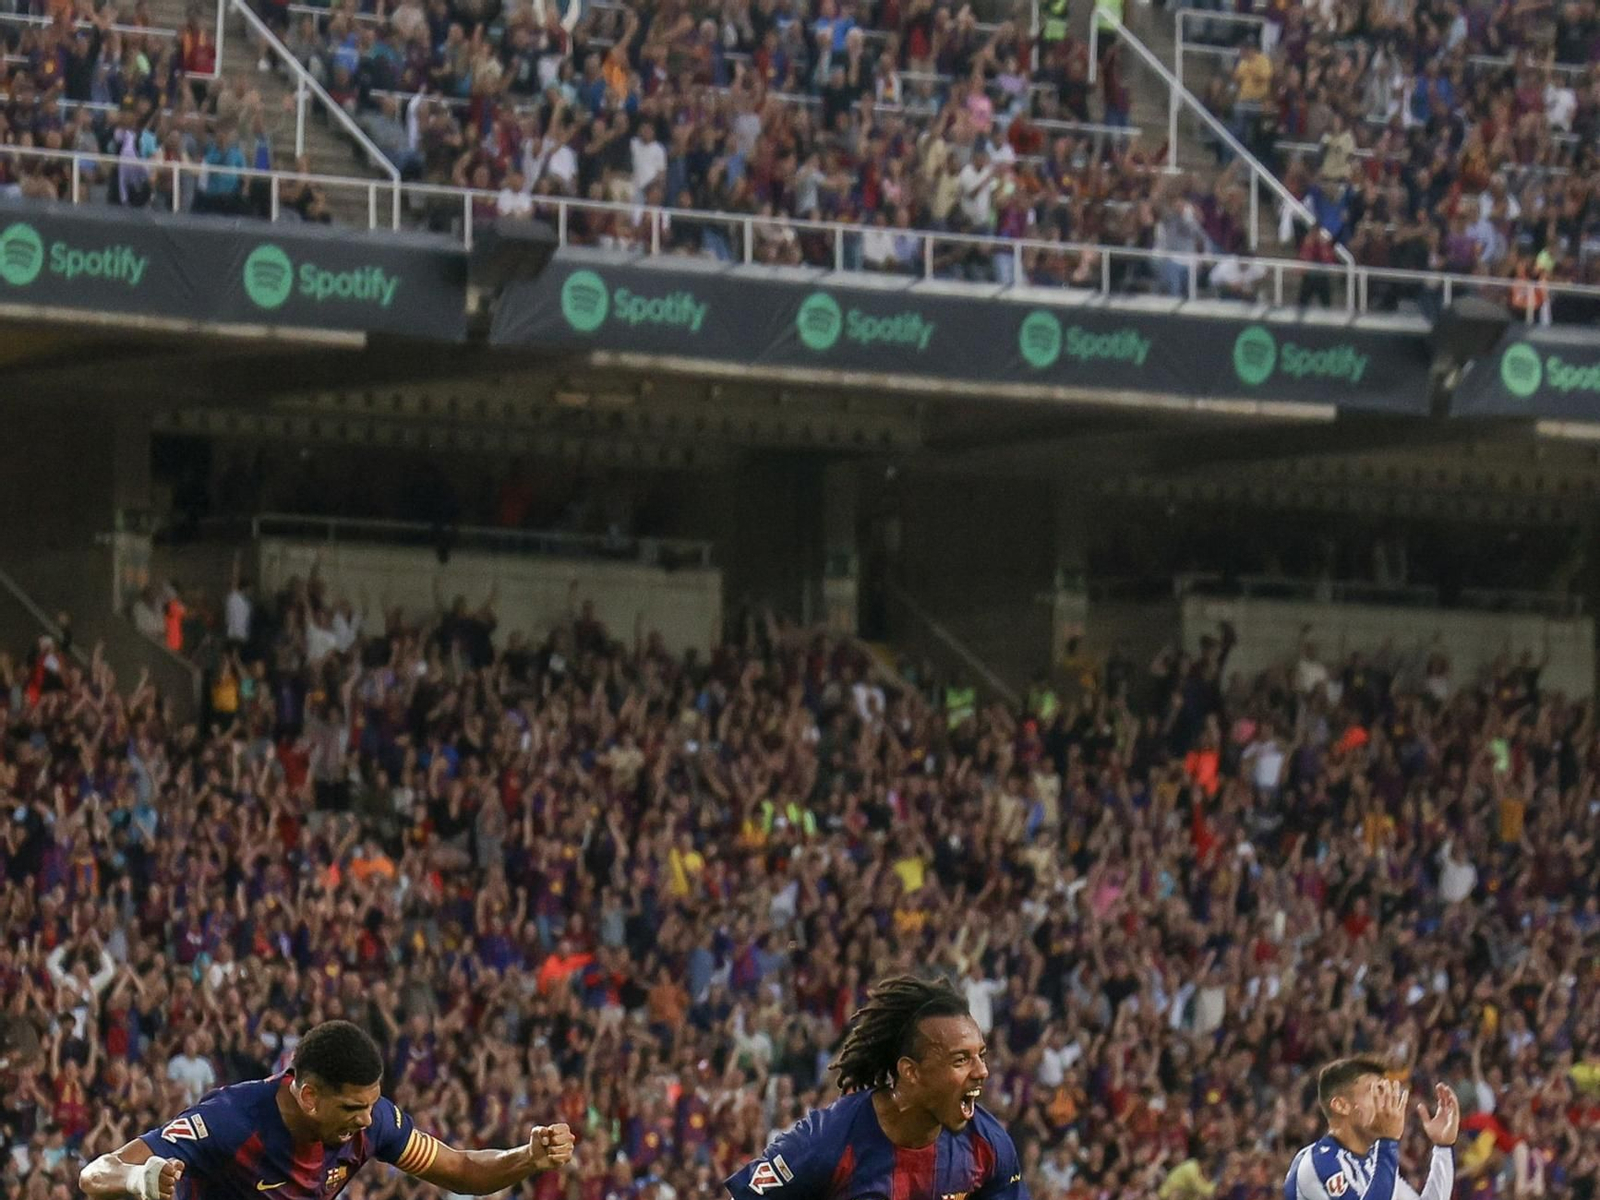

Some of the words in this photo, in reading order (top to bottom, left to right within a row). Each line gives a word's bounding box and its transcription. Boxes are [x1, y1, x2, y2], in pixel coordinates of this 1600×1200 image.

[49, 241, 148, 285] Spotify
[299, 263, 398, 307] Spotify
[613, 287, 707, 333] Spotify
[846, 309, 935, 352] Spotify
[1066, 325, 1151, 365] Spotify
[1280, 342, 1369, 383] Spotify
